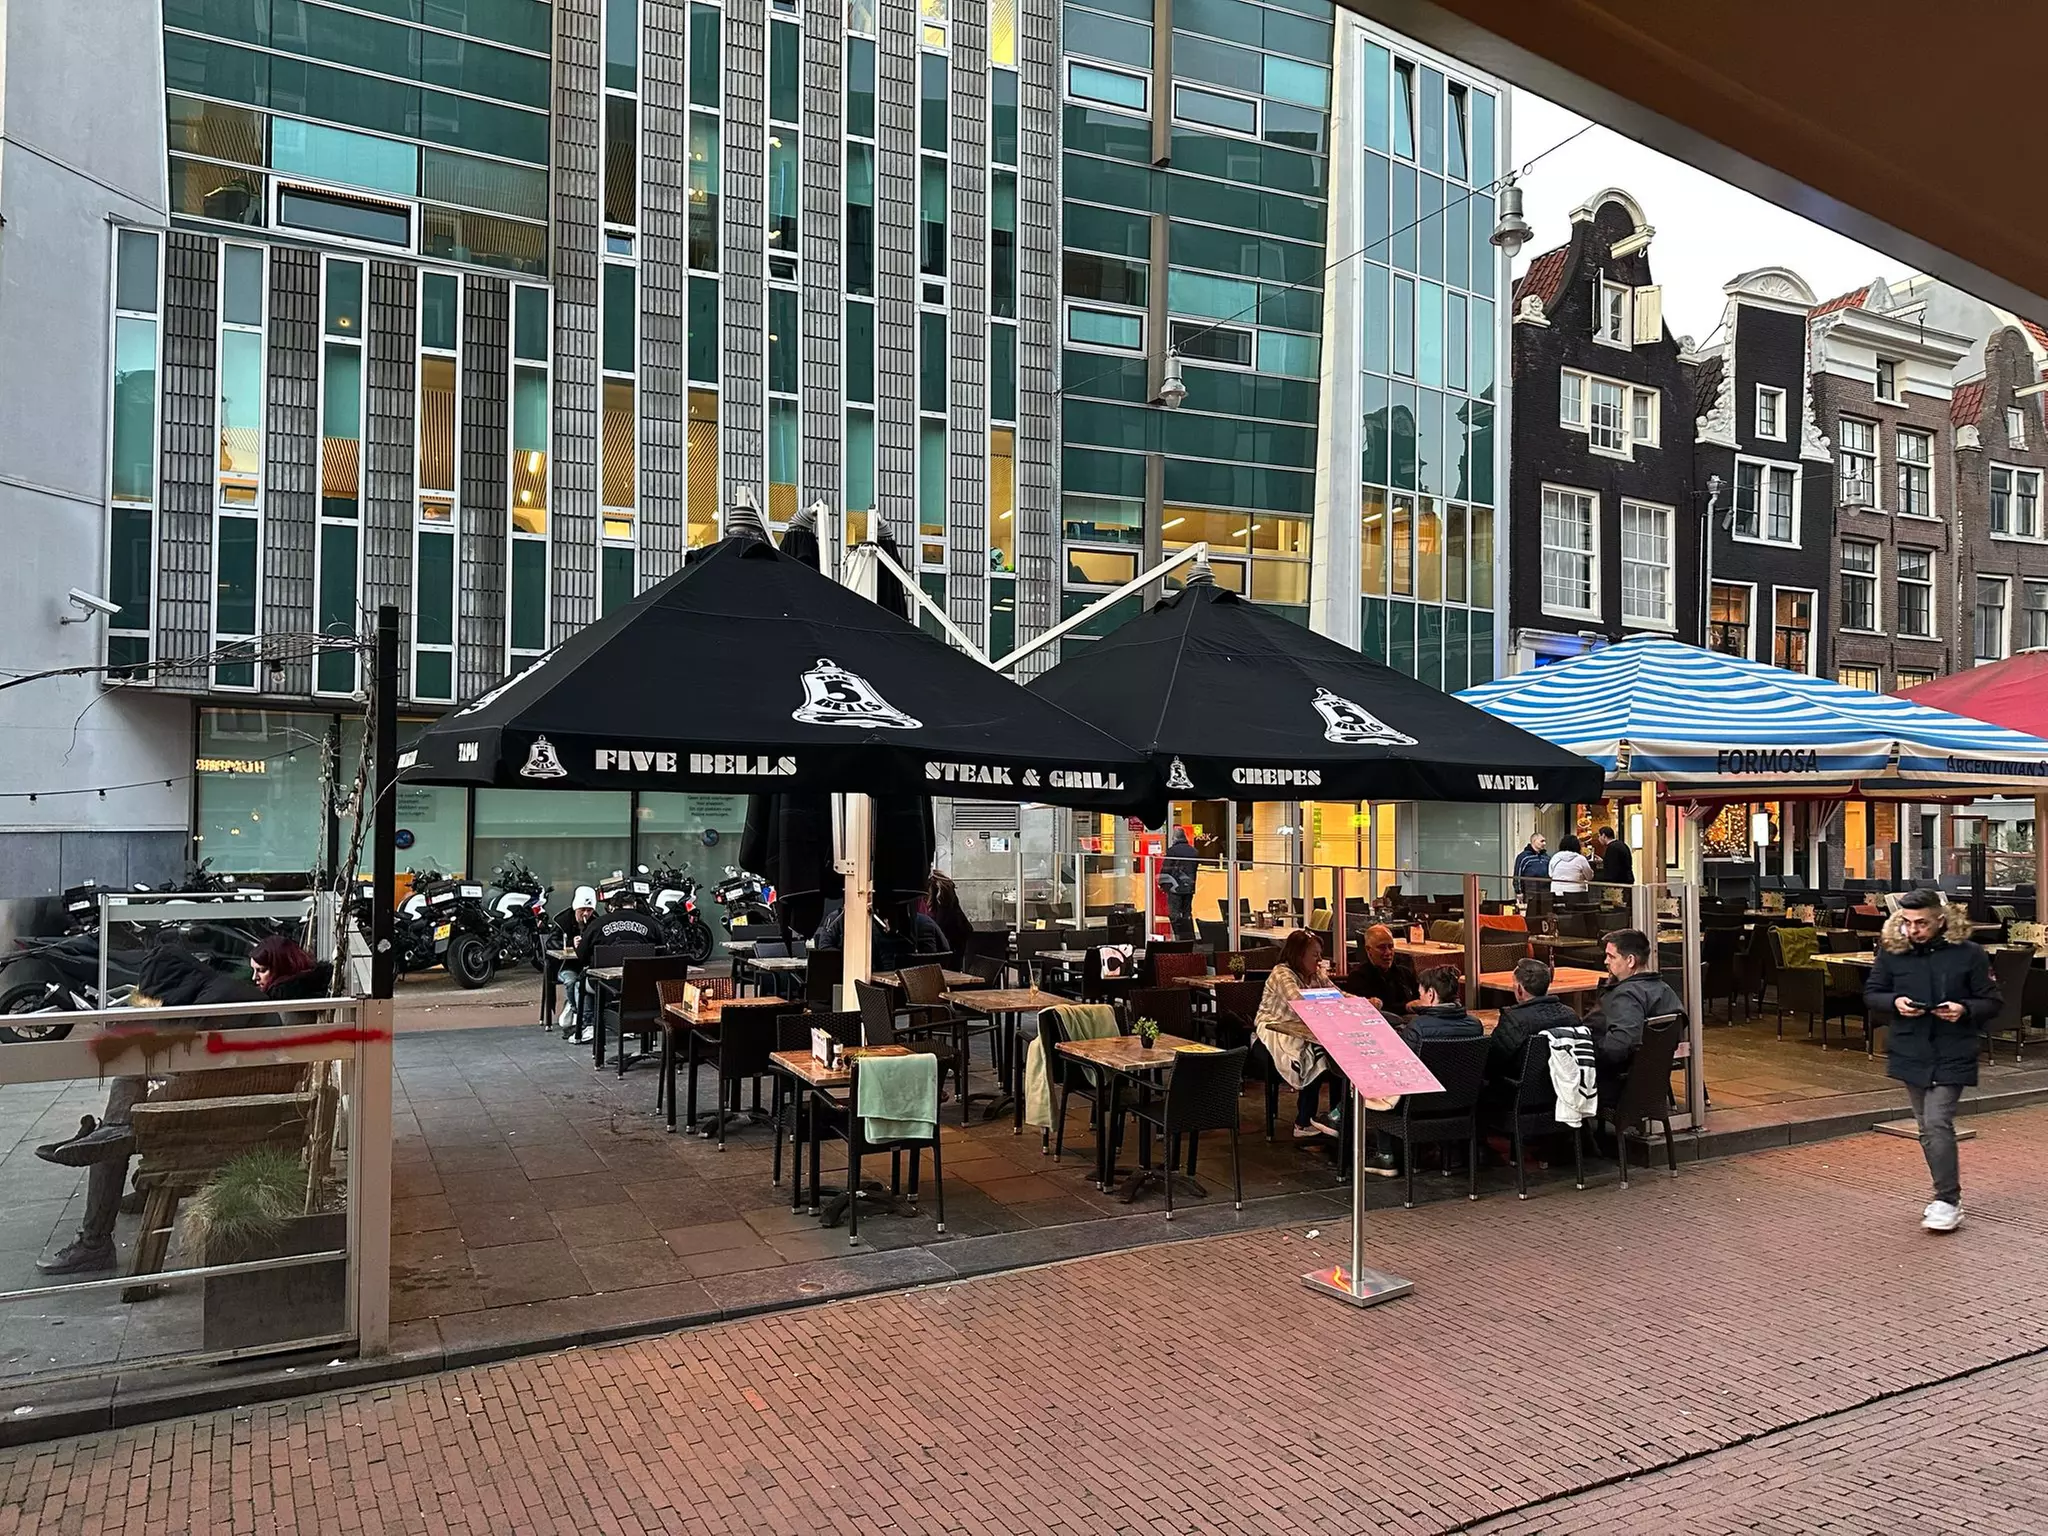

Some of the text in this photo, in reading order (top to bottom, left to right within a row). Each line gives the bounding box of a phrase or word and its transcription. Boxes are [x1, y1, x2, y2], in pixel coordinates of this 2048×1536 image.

[816, 674, 852, 682] THE
[823, 680, 862, 703] 5
[814, 698, 883, 713] BELLS
[1332, 705, 1366, 724] 5
[1334, 721, 1384, 733] BELLS
[537, 749, 550, 763] 5
[595, 749, 797, 775] FIVE BELLS
[1717, 749, 1819, 775] FORMOSA
[1946, 755, 2036, 777] ARGENTINIAN
[924, 761, 1125, 791] STEAK & GRILL
[1231, 767, 1322, 786] CREPES
[1476, 774, 1540, 791] WAFEL
[602, 921, 649, 937] SECOND
